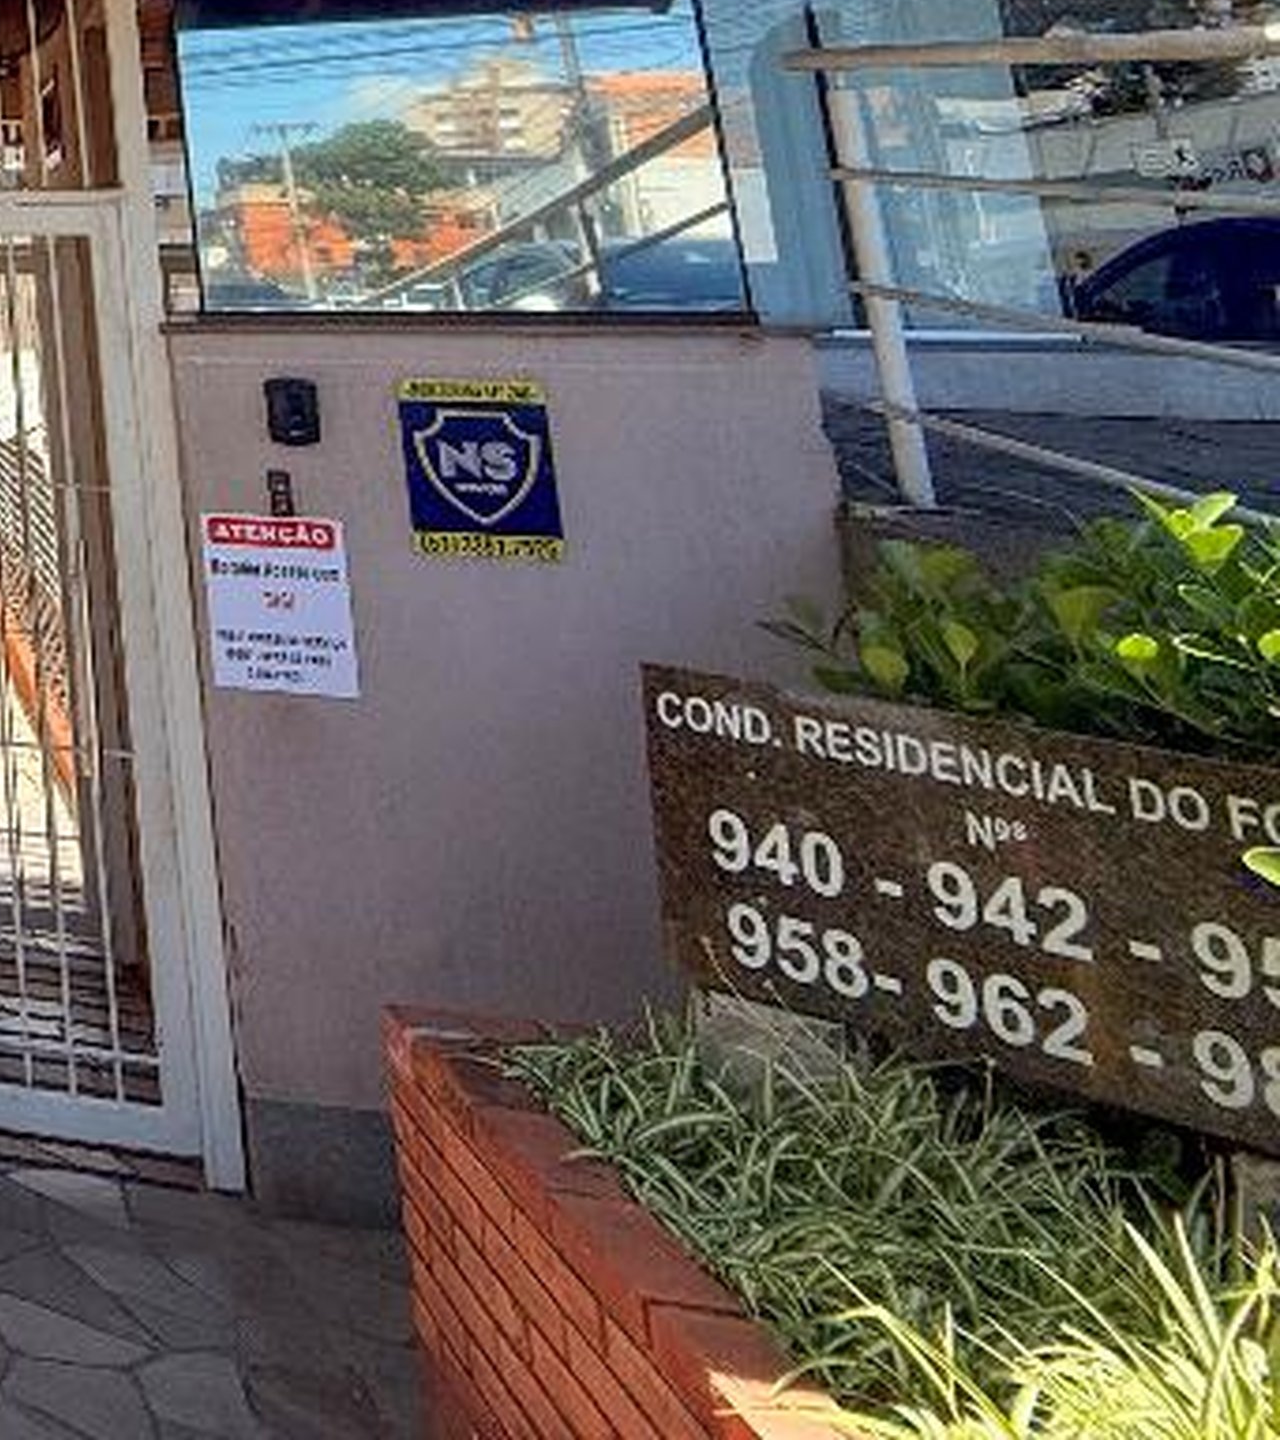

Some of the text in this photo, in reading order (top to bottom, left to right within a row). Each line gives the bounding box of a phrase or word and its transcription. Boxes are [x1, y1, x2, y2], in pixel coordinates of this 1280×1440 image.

[437, 440, 518, 482] NS
[214, 523, 330, 545] ATENÇÃO
[656, 691, 782, 748] COND.
[794, 715, 1116, 814] RESIDENCIAL
[1129, 778, 1210, 830] DO
[708, 809, 844, 897] 940
[927, 861, 1093, 961] 942
[926, 958, 1094, 1066] 962
